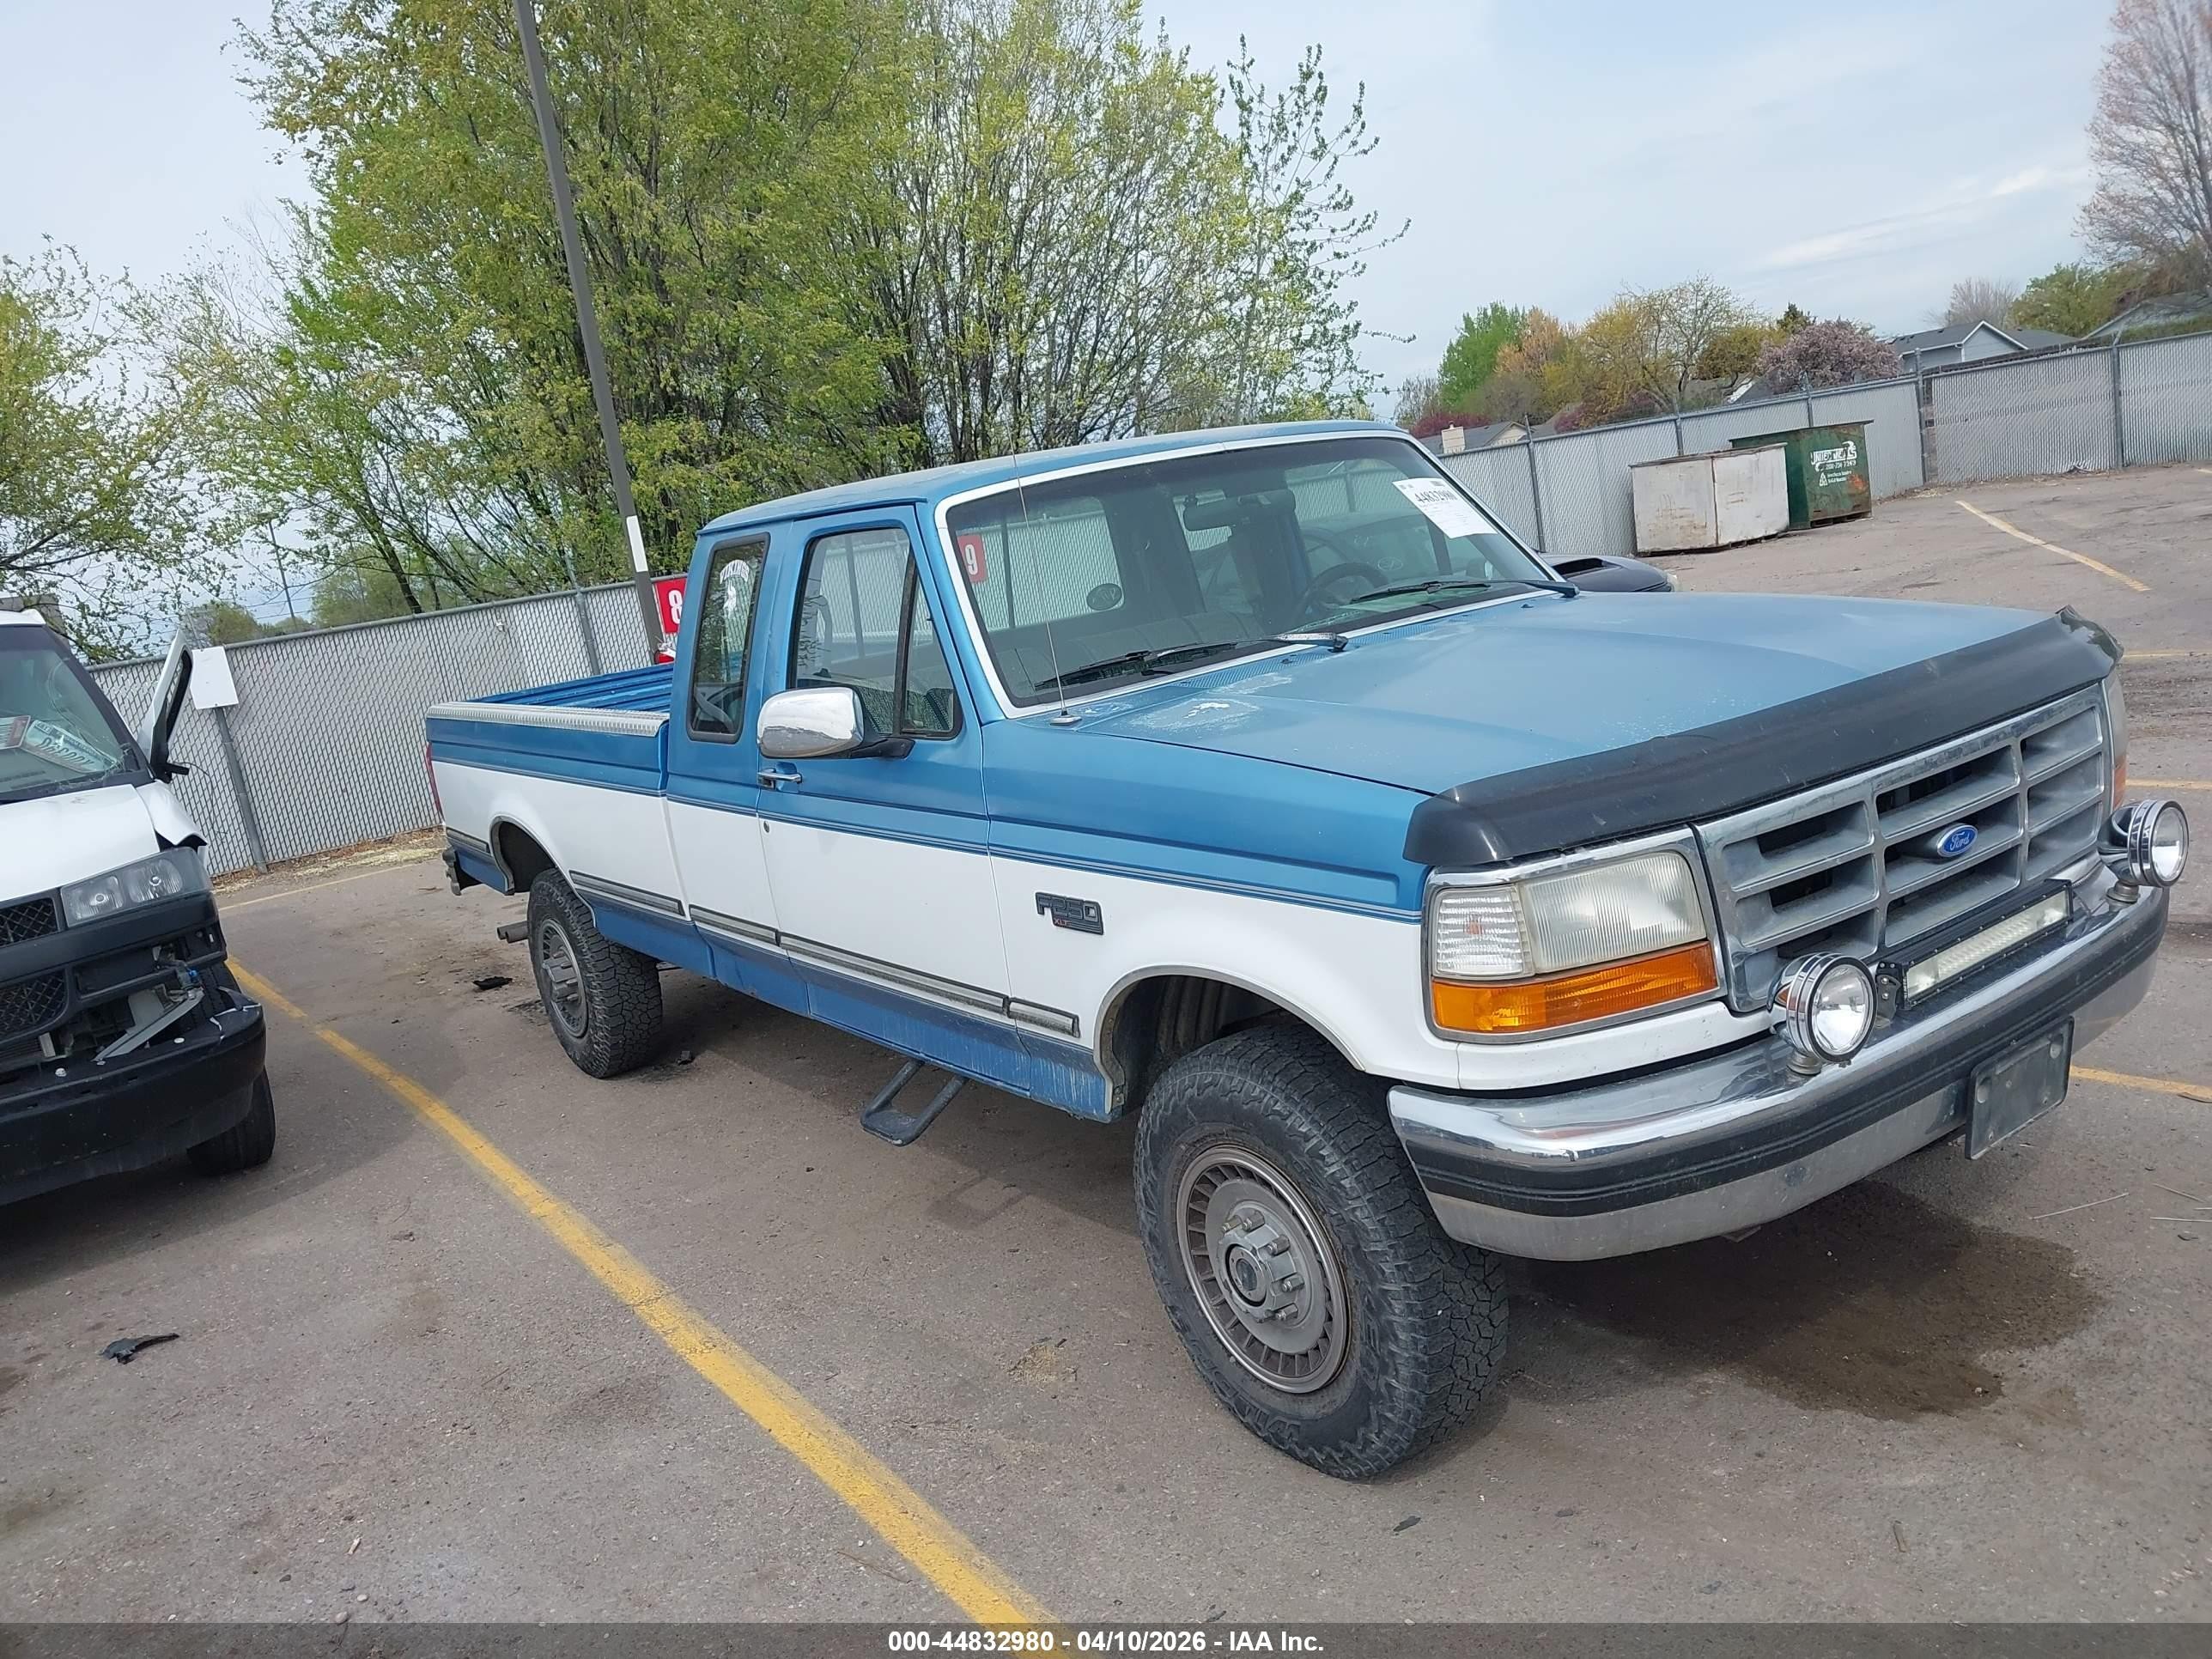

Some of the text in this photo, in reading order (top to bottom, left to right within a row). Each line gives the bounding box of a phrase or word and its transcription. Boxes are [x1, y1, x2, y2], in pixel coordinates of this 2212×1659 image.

[964, 544, 978, 575] 9
[668, 589, 684, 624] 8
[1949, 831, 1971, 851] Ford
[1036, 893, 1099, 923] F250
[1053, 917, 1069, 927] XLT
